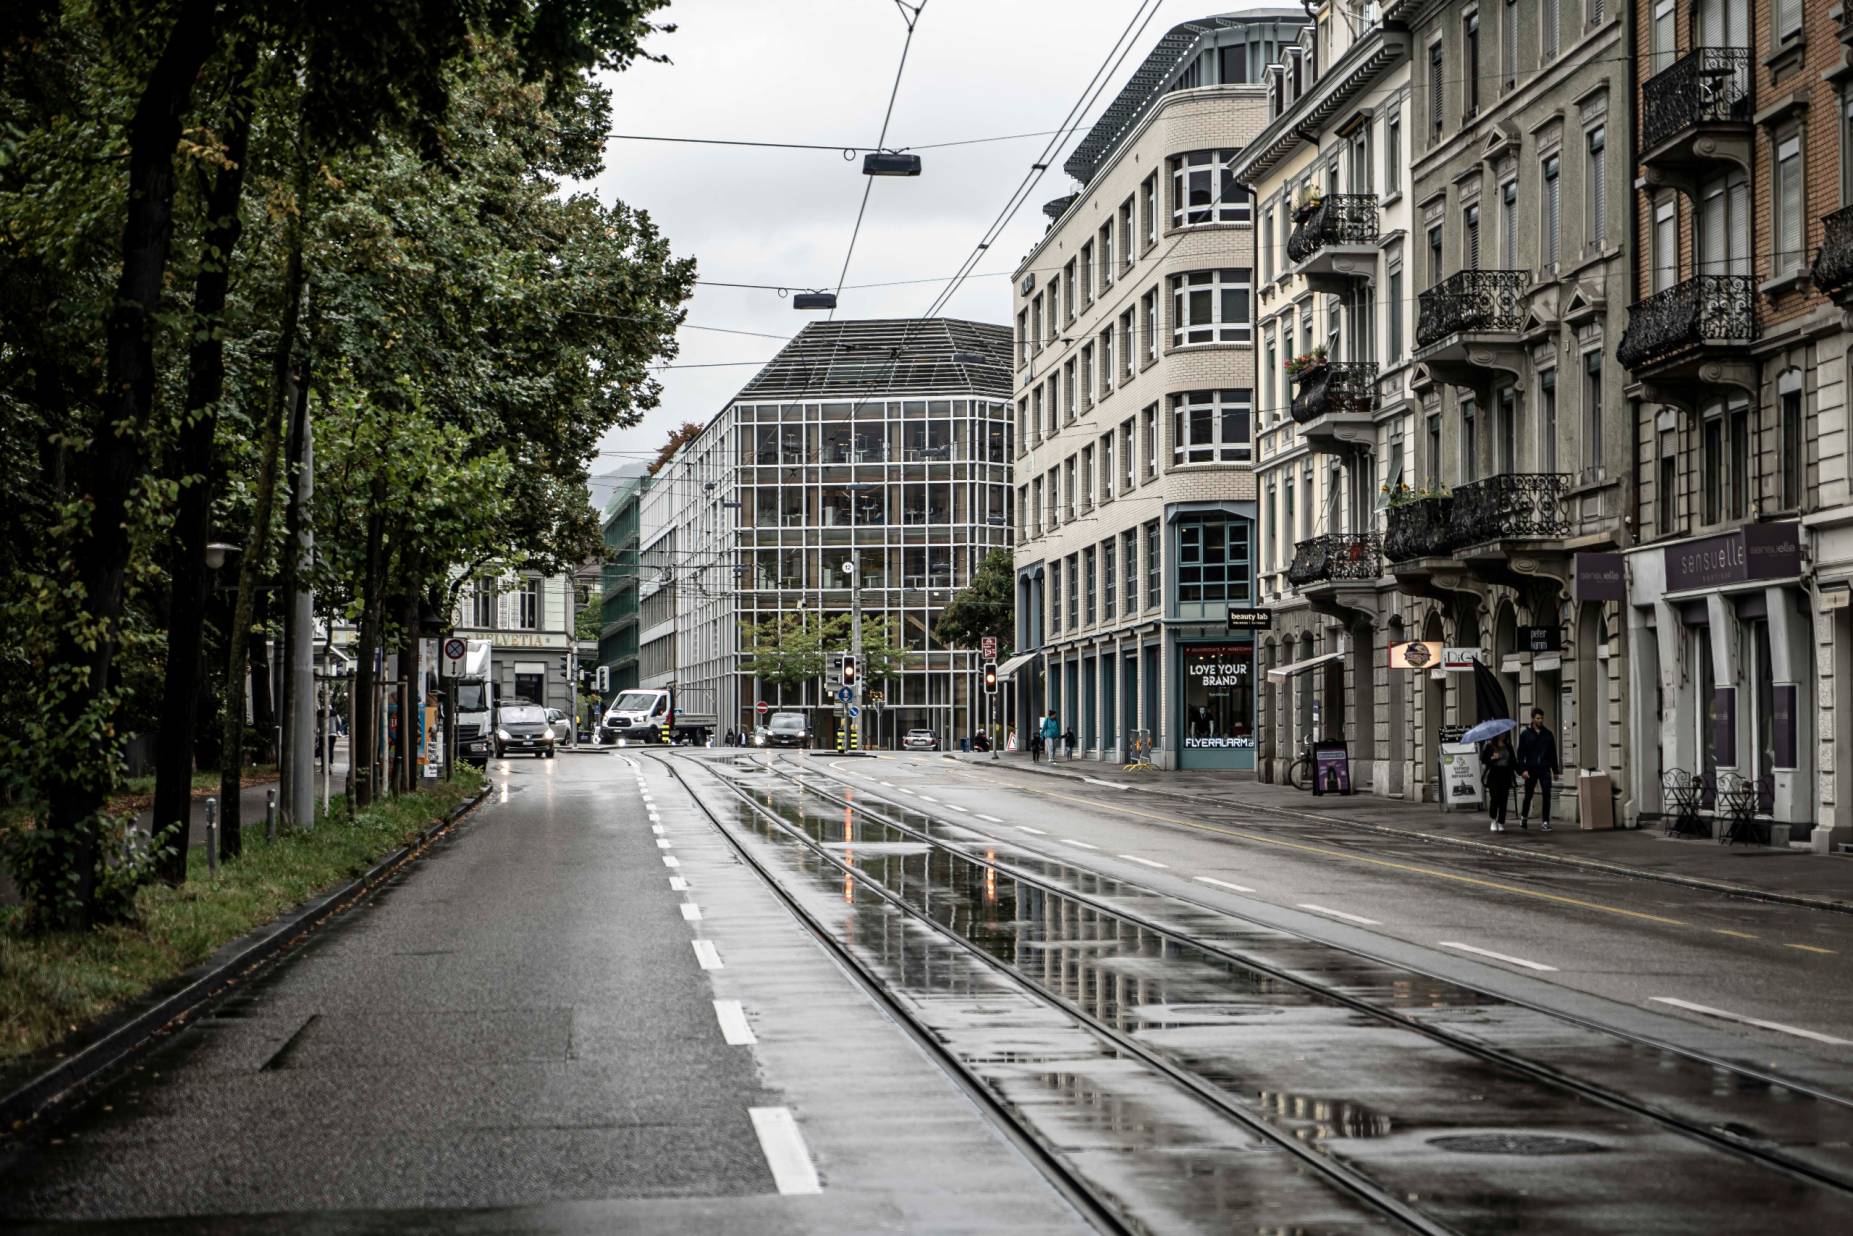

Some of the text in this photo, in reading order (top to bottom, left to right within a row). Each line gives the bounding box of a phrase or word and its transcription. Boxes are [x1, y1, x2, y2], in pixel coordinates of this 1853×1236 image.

[1681, 535, 1744, 575] sensuelle
[1231, 612, 1268, 622] beauty lab
[1190, 663, 1247, 676] LOVE YOUR
[1203, 674, 1237, 687] BRAND
